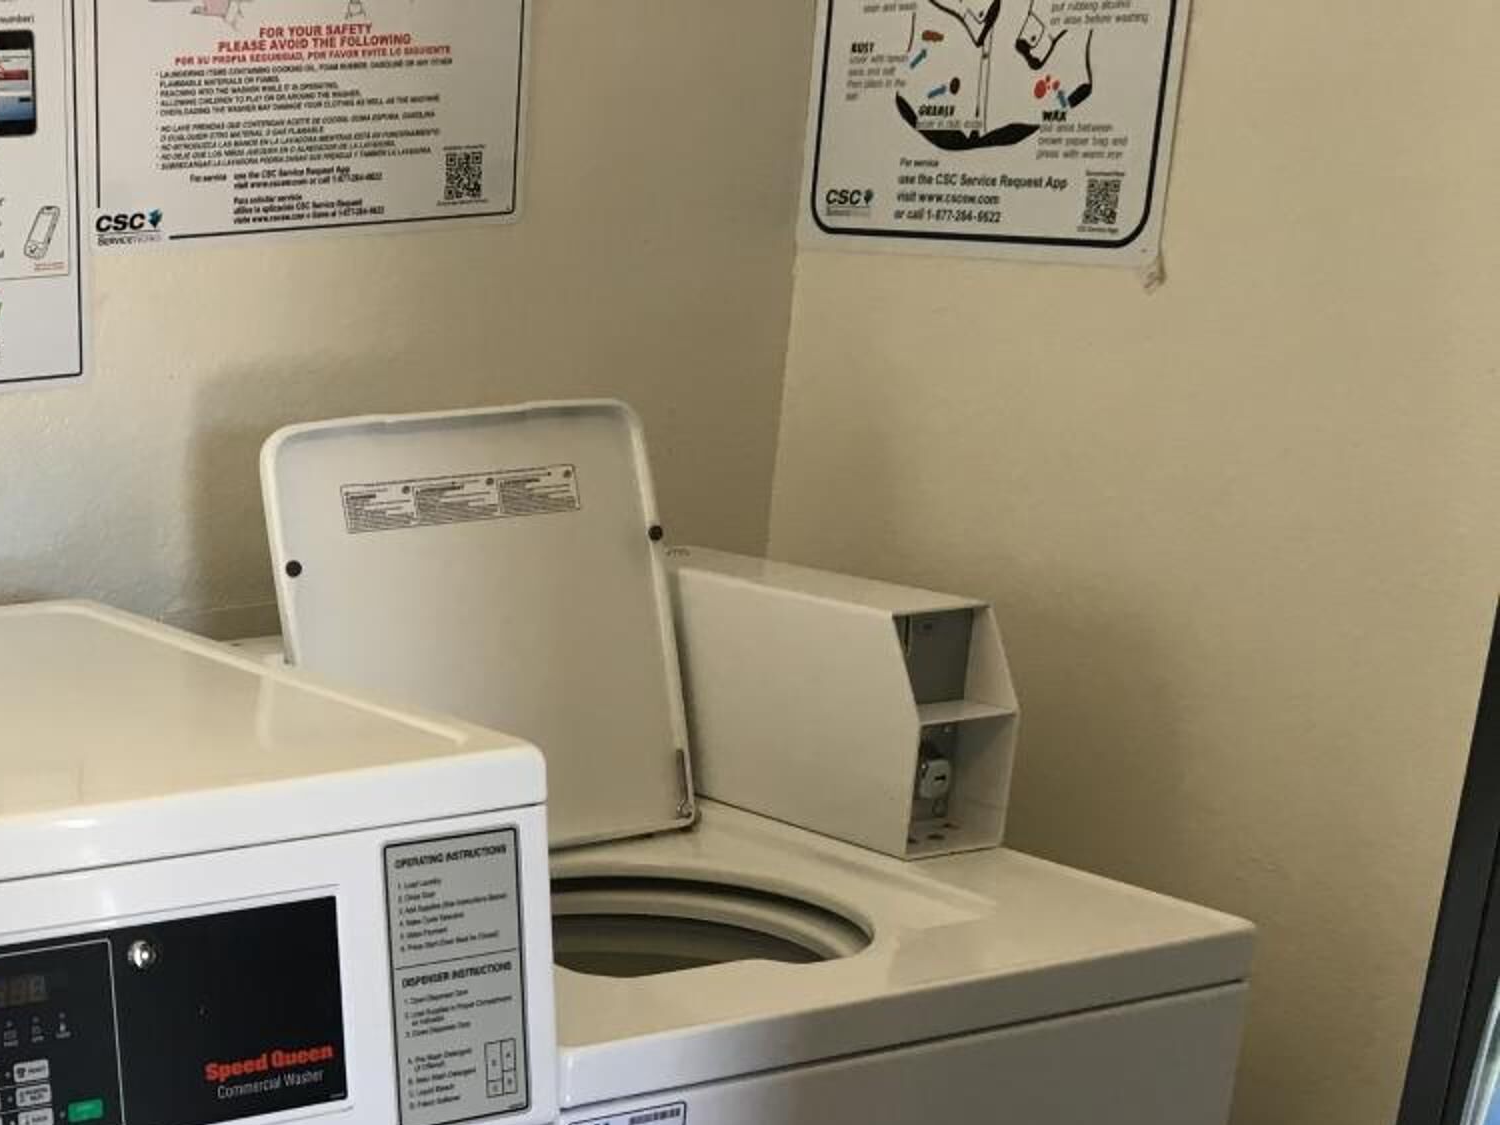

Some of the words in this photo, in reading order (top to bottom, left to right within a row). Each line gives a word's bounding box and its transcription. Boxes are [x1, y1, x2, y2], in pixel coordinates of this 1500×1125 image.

[259, 27, 285, 38] FOR
[288, 26, 322, 36] YOUR
[325, 24, 372, 35] SAFETY
[218, 40, 266, 52] PLEASE
[269, 35, 308, 50] AVOID
[312, 37, 336, 48] THE
[340, 32, 411, 46] FOLLOWING
[175, 57, 194, 65] POR
[212, 55, 246, 63] PROPIA
[307, 51, 326, 60] POR
[329, 50, 358, 58] FAVOR
[362, 48, 387, 56] EVITE
[390, 48, 401, 56] LO
[403, 45, 450, 55] SIGUIENTE
[1042, 110, 1067, 122] WAX
[306, 167, 334, 175] Request
[899, 175, 915, 184] use
[918, 174, 933, 184] the
[936, 174, 957, 185] CSC
[960, 174, 997, 186] Service
[1000, 175, 1043, 188] Request
[1045, 177, 1068, 190] App
[826, 189, 861, 205] CSC
[897, 192, 916, 202] visit
[894, 210, 904, 219] or
[906, 208, 925, 219] call
[96, 213, 146, 232] CSC
[394, 853, 444, 869] OPERATING
[445, 844, 507, 862] INSTRUCTIONS
[401, 971, 449, 989] DISPENSER
[451, 961, 512, 980] INSTRUCTIONS
[204, 1054, 268, 1082] Speed
[271, 1044, 334, 1069] Queen
[217, 1076, 281, 1099] Commercial
[283, 1068, 325, 1087] Washer
